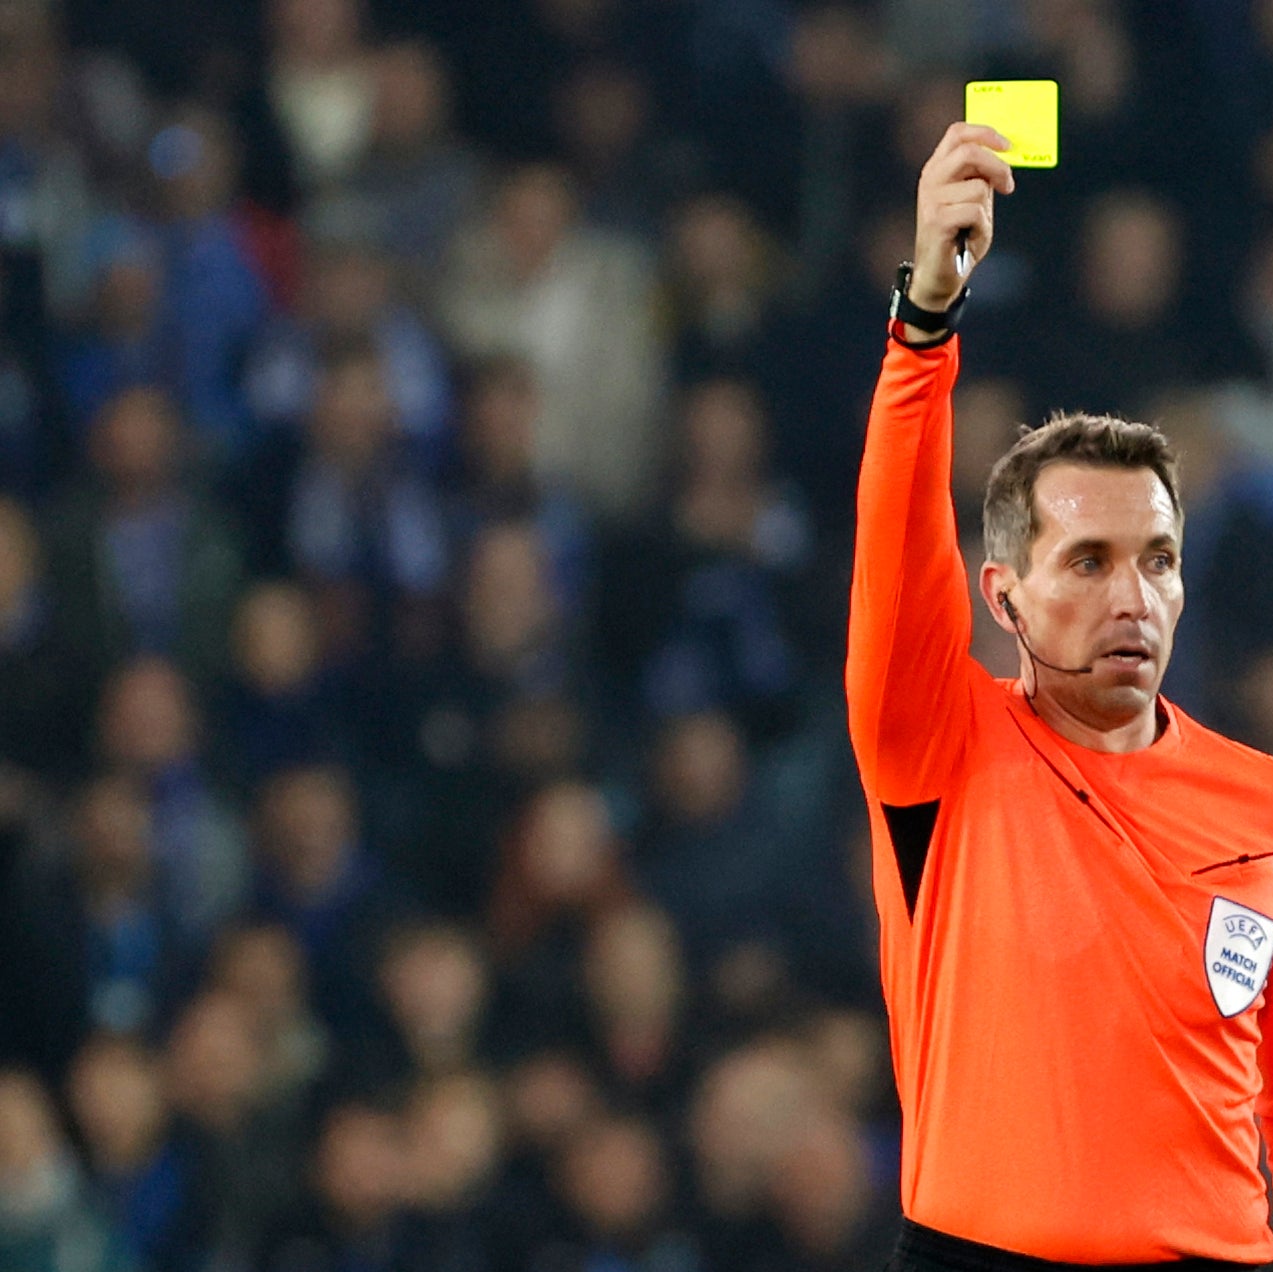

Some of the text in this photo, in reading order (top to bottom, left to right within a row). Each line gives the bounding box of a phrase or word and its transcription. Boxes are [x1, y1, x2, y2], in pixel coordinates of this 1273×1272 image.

[1224, 918, 1265, 947] UEFA
[1220, 947, 1258, 973] MATCH
[1212, 961, 1256, 992] OFFICIAL
